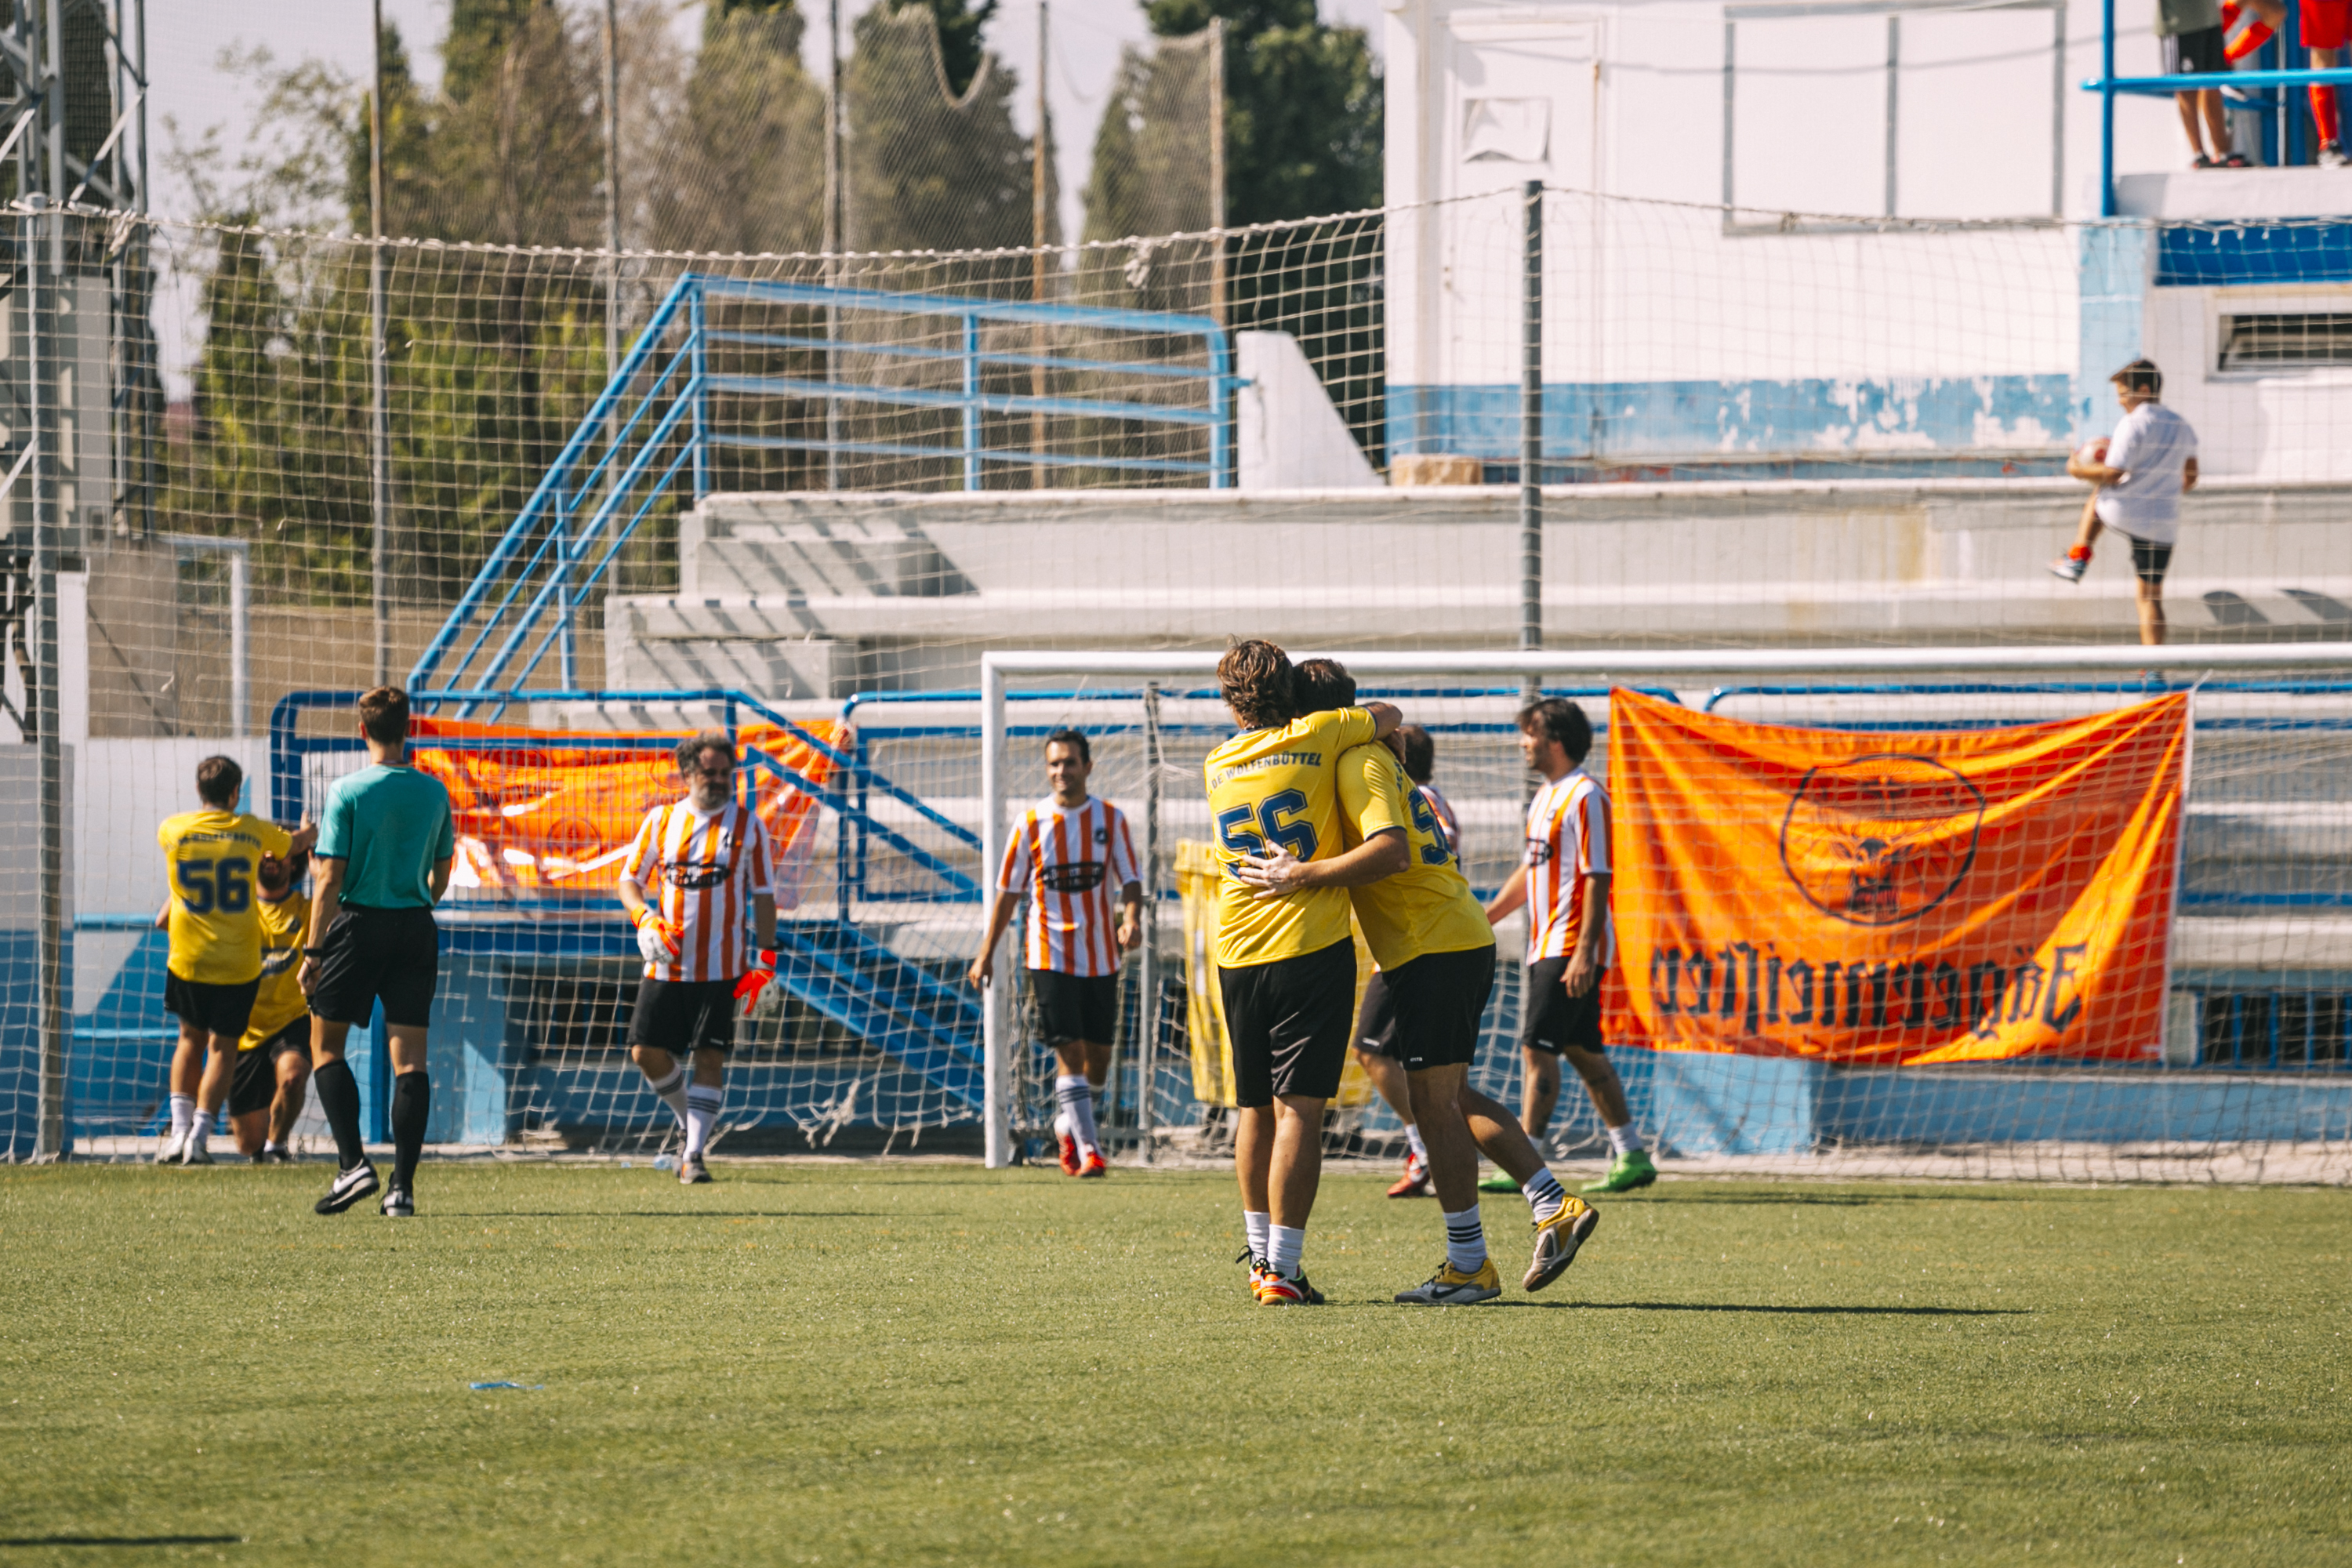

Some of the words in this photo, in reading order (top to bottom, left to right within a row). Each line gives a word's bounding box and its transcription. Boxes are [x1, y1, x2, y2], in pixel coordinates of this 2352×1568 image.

[1226, 750, 1322, 779] WOLFENBÜTTEL
[1217, 788, 1319, 880] 56
[176, 857, 252, 915] 56
